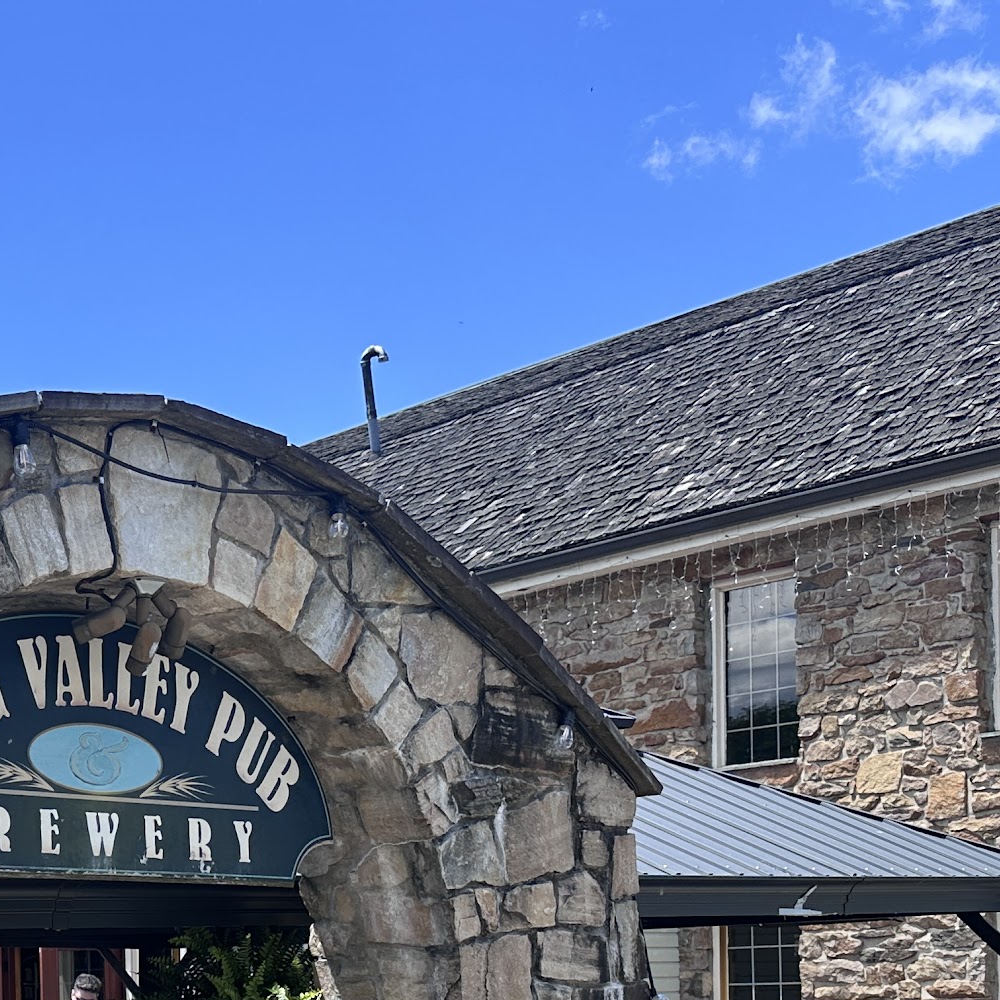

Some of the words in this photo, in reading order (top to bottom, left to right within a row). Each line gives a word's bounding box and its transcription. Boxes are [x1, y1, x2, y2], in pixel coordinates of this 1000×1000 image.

[16, 634, 200, 735] VALLEY
[205, 690, 300, 813] PUB
[69, 731, 128, 787] &
